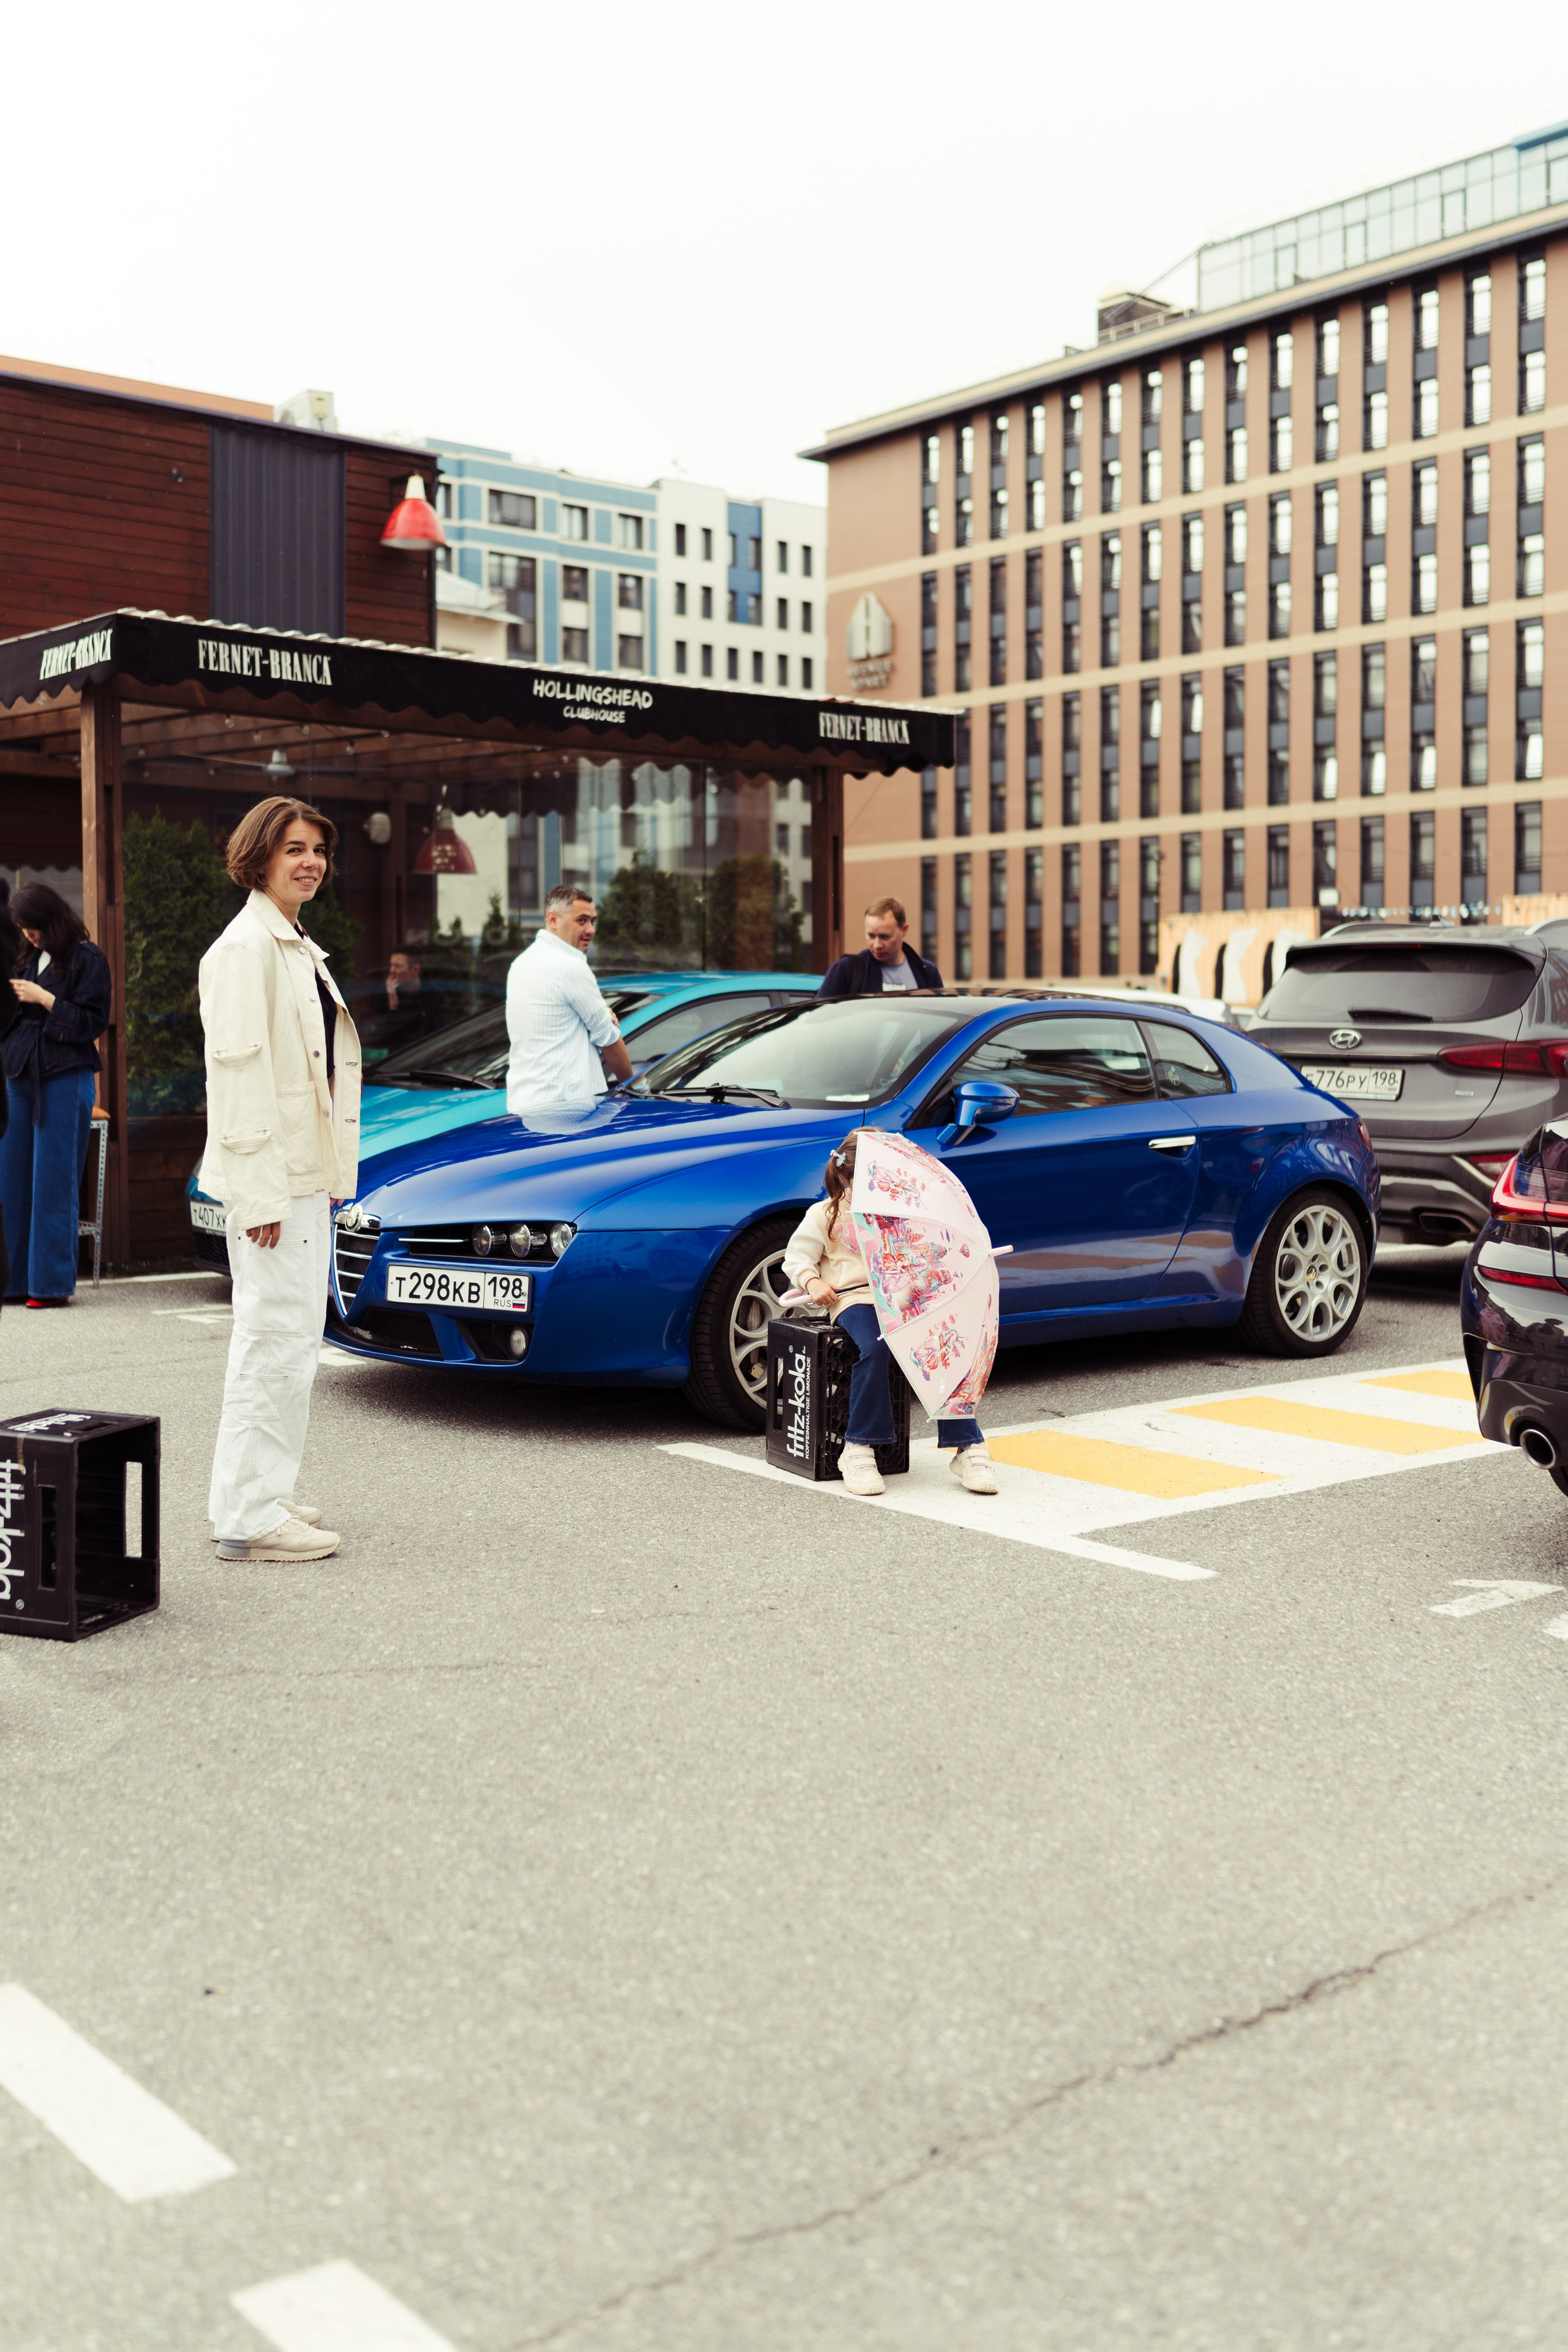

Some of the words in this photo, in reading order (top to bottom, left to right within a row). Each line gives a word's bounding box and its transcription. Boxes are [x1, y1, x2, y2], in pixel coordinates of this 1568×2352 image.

[39, 628, 113, 680] FERNET-BRANCA
[198, 638, 333, 686] FERNET-BRANCA
[533, 679, 653, 709] HOLLINGSHEAD
[563, 706, 626, 723] CLUBHOUSE
[819, 712, 910, 745] FERNET-BRANCA
[1372, 1072, 1396, 1085] 198
[488, 1276, 523, 1299] 198
[494, 1298, 512, 1308] RUS
